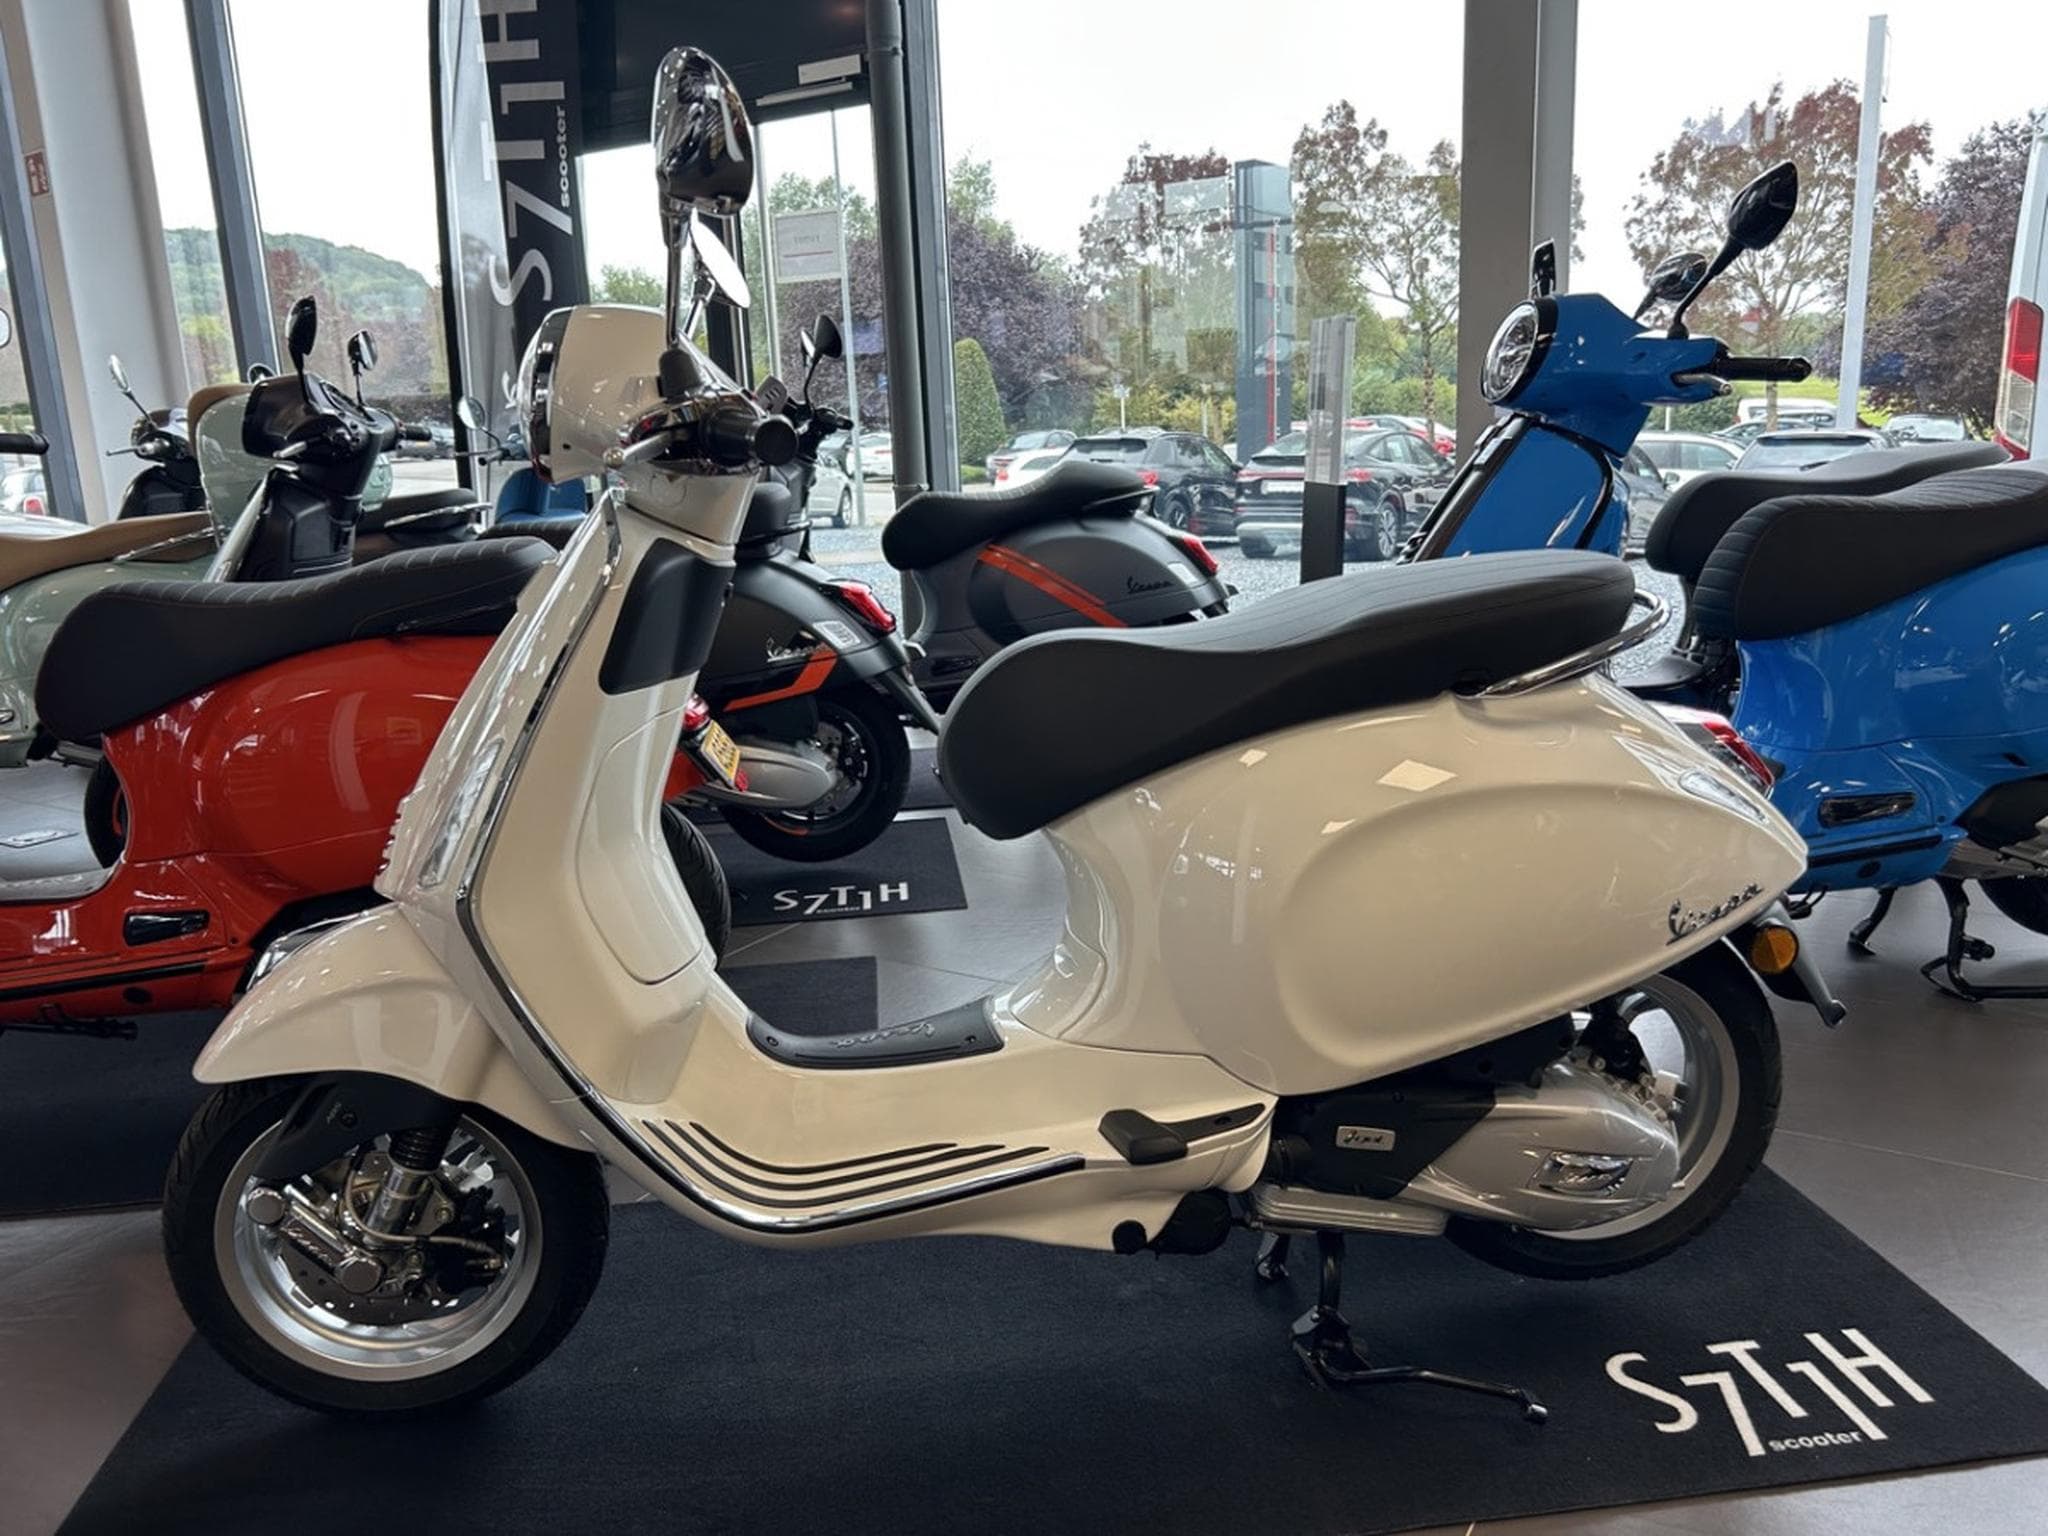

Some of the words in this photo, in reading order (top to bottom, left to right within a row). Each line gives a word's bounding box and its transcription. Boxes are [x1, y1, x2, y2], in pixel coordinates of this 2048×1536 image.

[556, 105, 571, 208] scooter
[1665, 883, 1764, 946] Vespa
[1768, 1429, 1863, 1453] scooter
